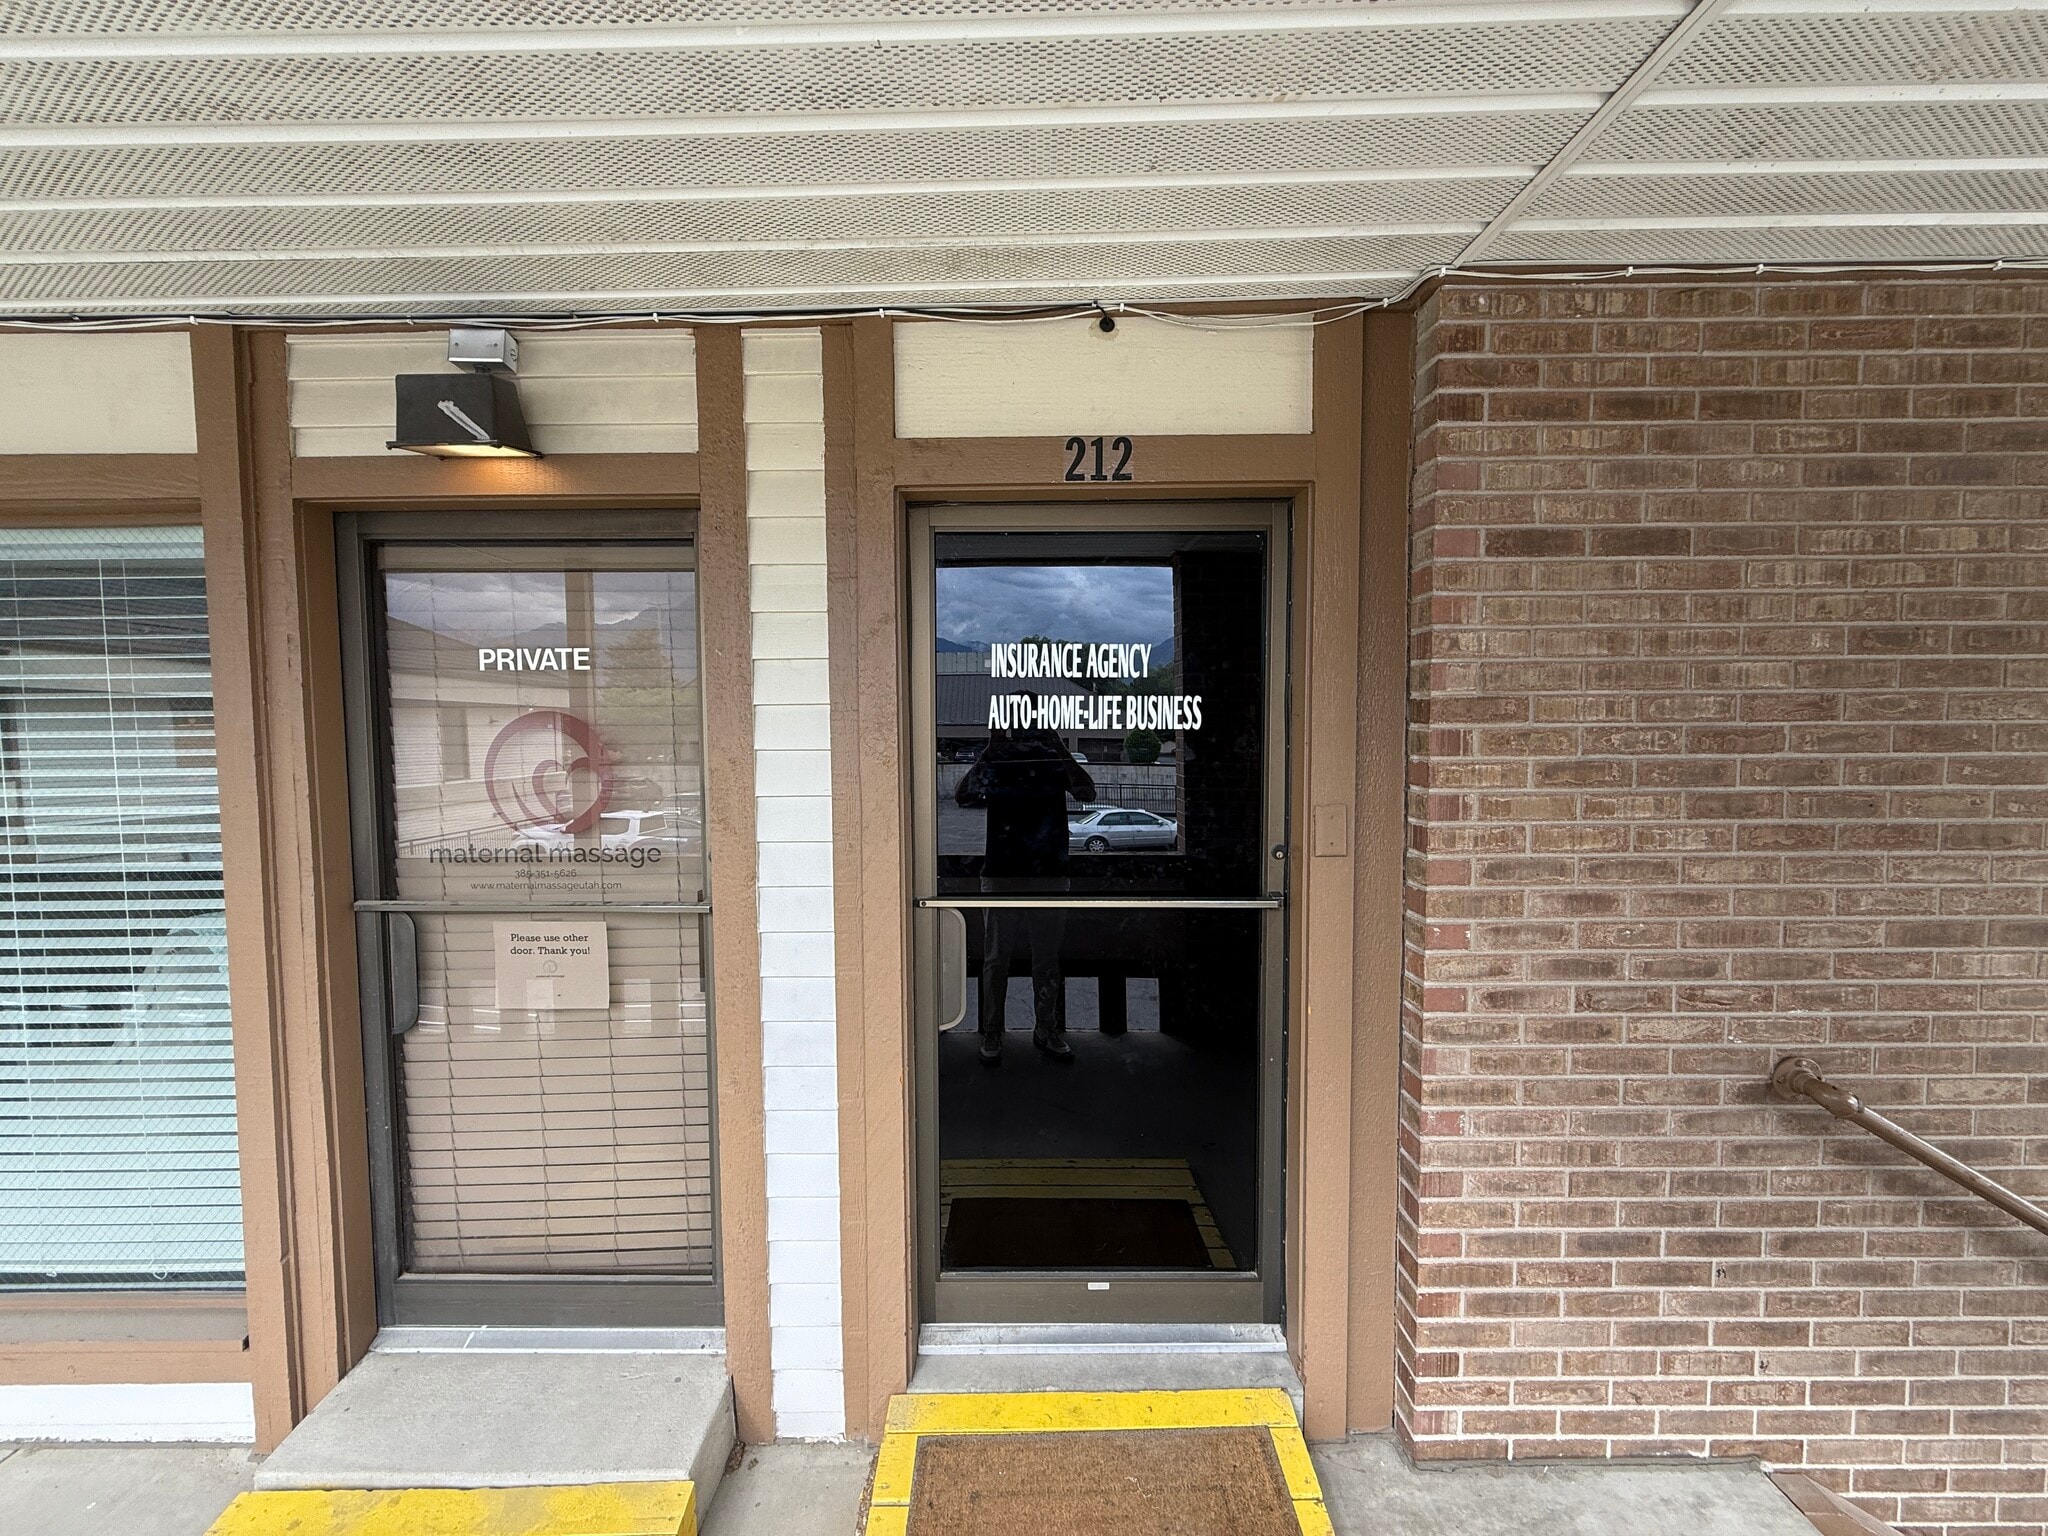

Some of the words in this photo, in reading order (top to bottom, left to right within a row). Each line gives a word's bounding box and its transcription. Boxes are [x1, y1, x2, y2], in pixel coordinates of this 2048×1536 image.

[1065, 436, 1133, 481] 212
[478, 647, 591, 671] PRIVATE
[990, 643, 1083, 678] INSURANCE
[1086, 643, 1152, 678] AGENCY
[1126, 695, 1202, 731] BUSINESS
[429, 842, 543, 863] maternal
[549, 846, 662, 868] massage
[514, 868, 577, 879] 385-351-5626
[470, 881, 622, 891] www.maternalmassageutah.com
[510, 933, 541, 942] Please
[543, 934, 560, 942] use
[562, 933, 589, 942] other
[510, 946, 535, 955] door.
[537, 946, 568, 955] Thank
[569, 946, 591, 957] you!
